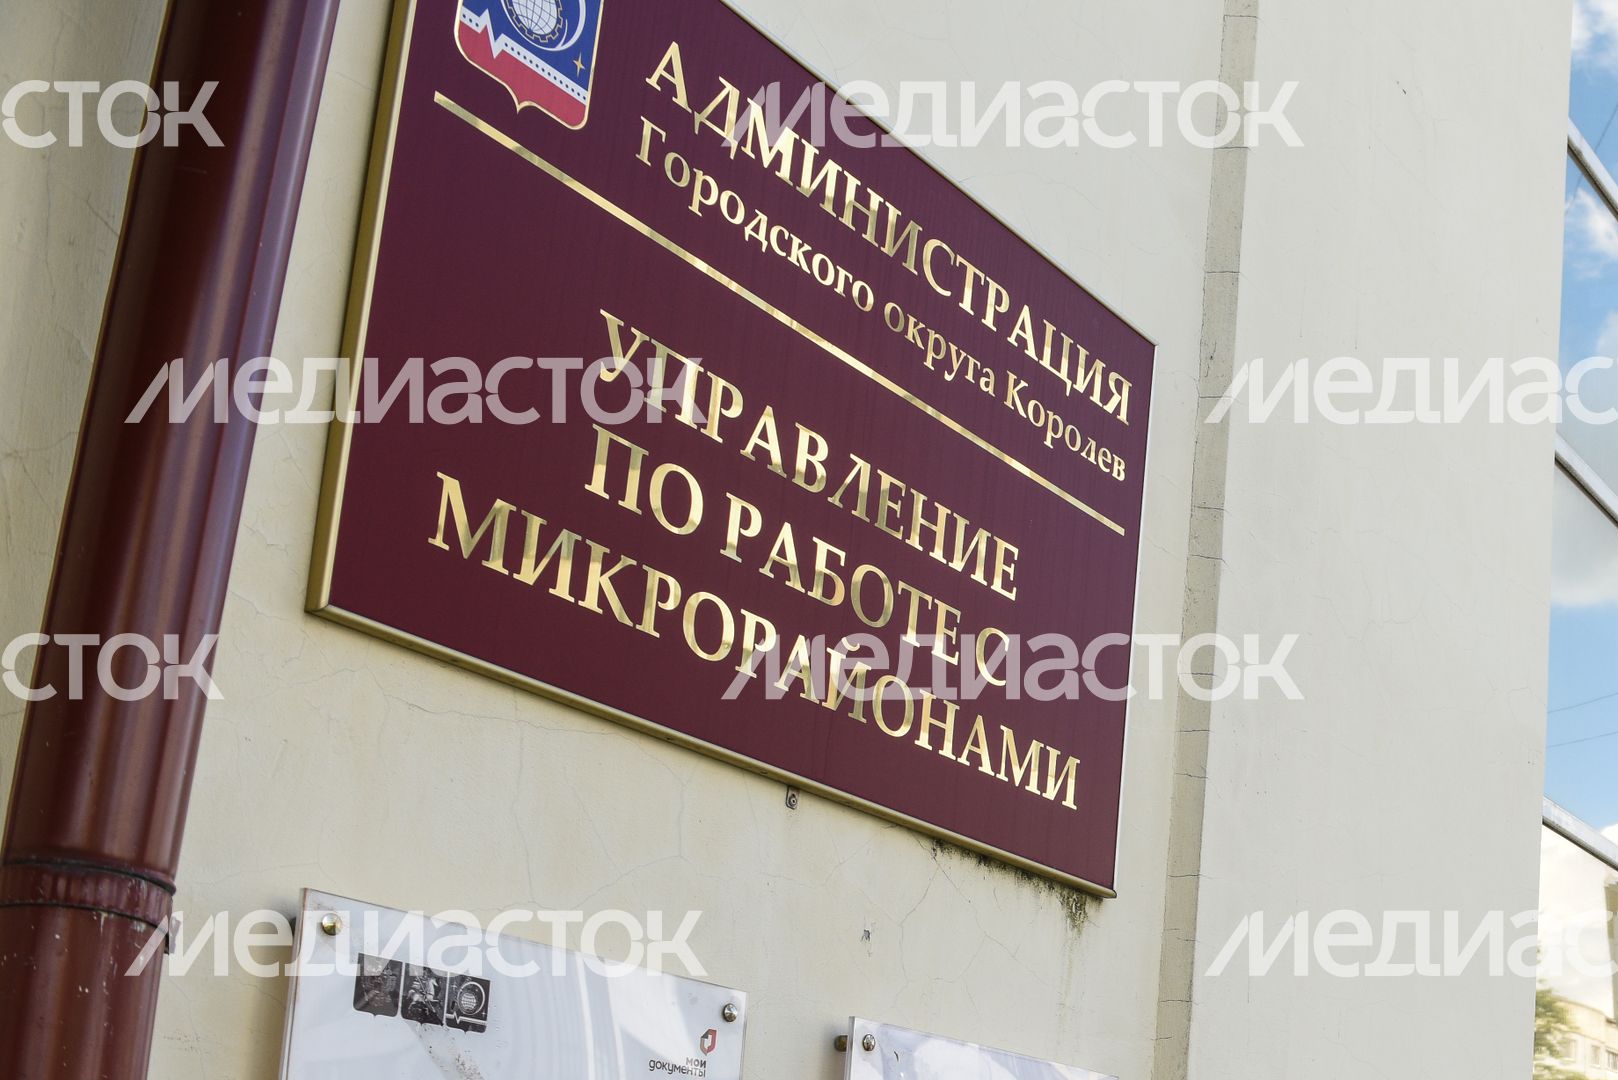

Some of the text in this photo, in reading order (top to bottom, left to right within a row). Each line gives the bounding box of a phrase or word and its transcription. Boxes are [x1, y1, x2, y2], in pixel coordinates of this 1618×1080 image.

[635, 115, 1126, 482] Городского округа Королев
[646, 41, 1132, 426] АДМИНИСТРАЦИЯ
[584, 423, 1010, 686] ПО РАБОТЕ С
[600, 308, 1019, 601] УПРАВЛЕНИЕ
[428, 471, 1080, 810] МИКРОРАЙОНАМИ
